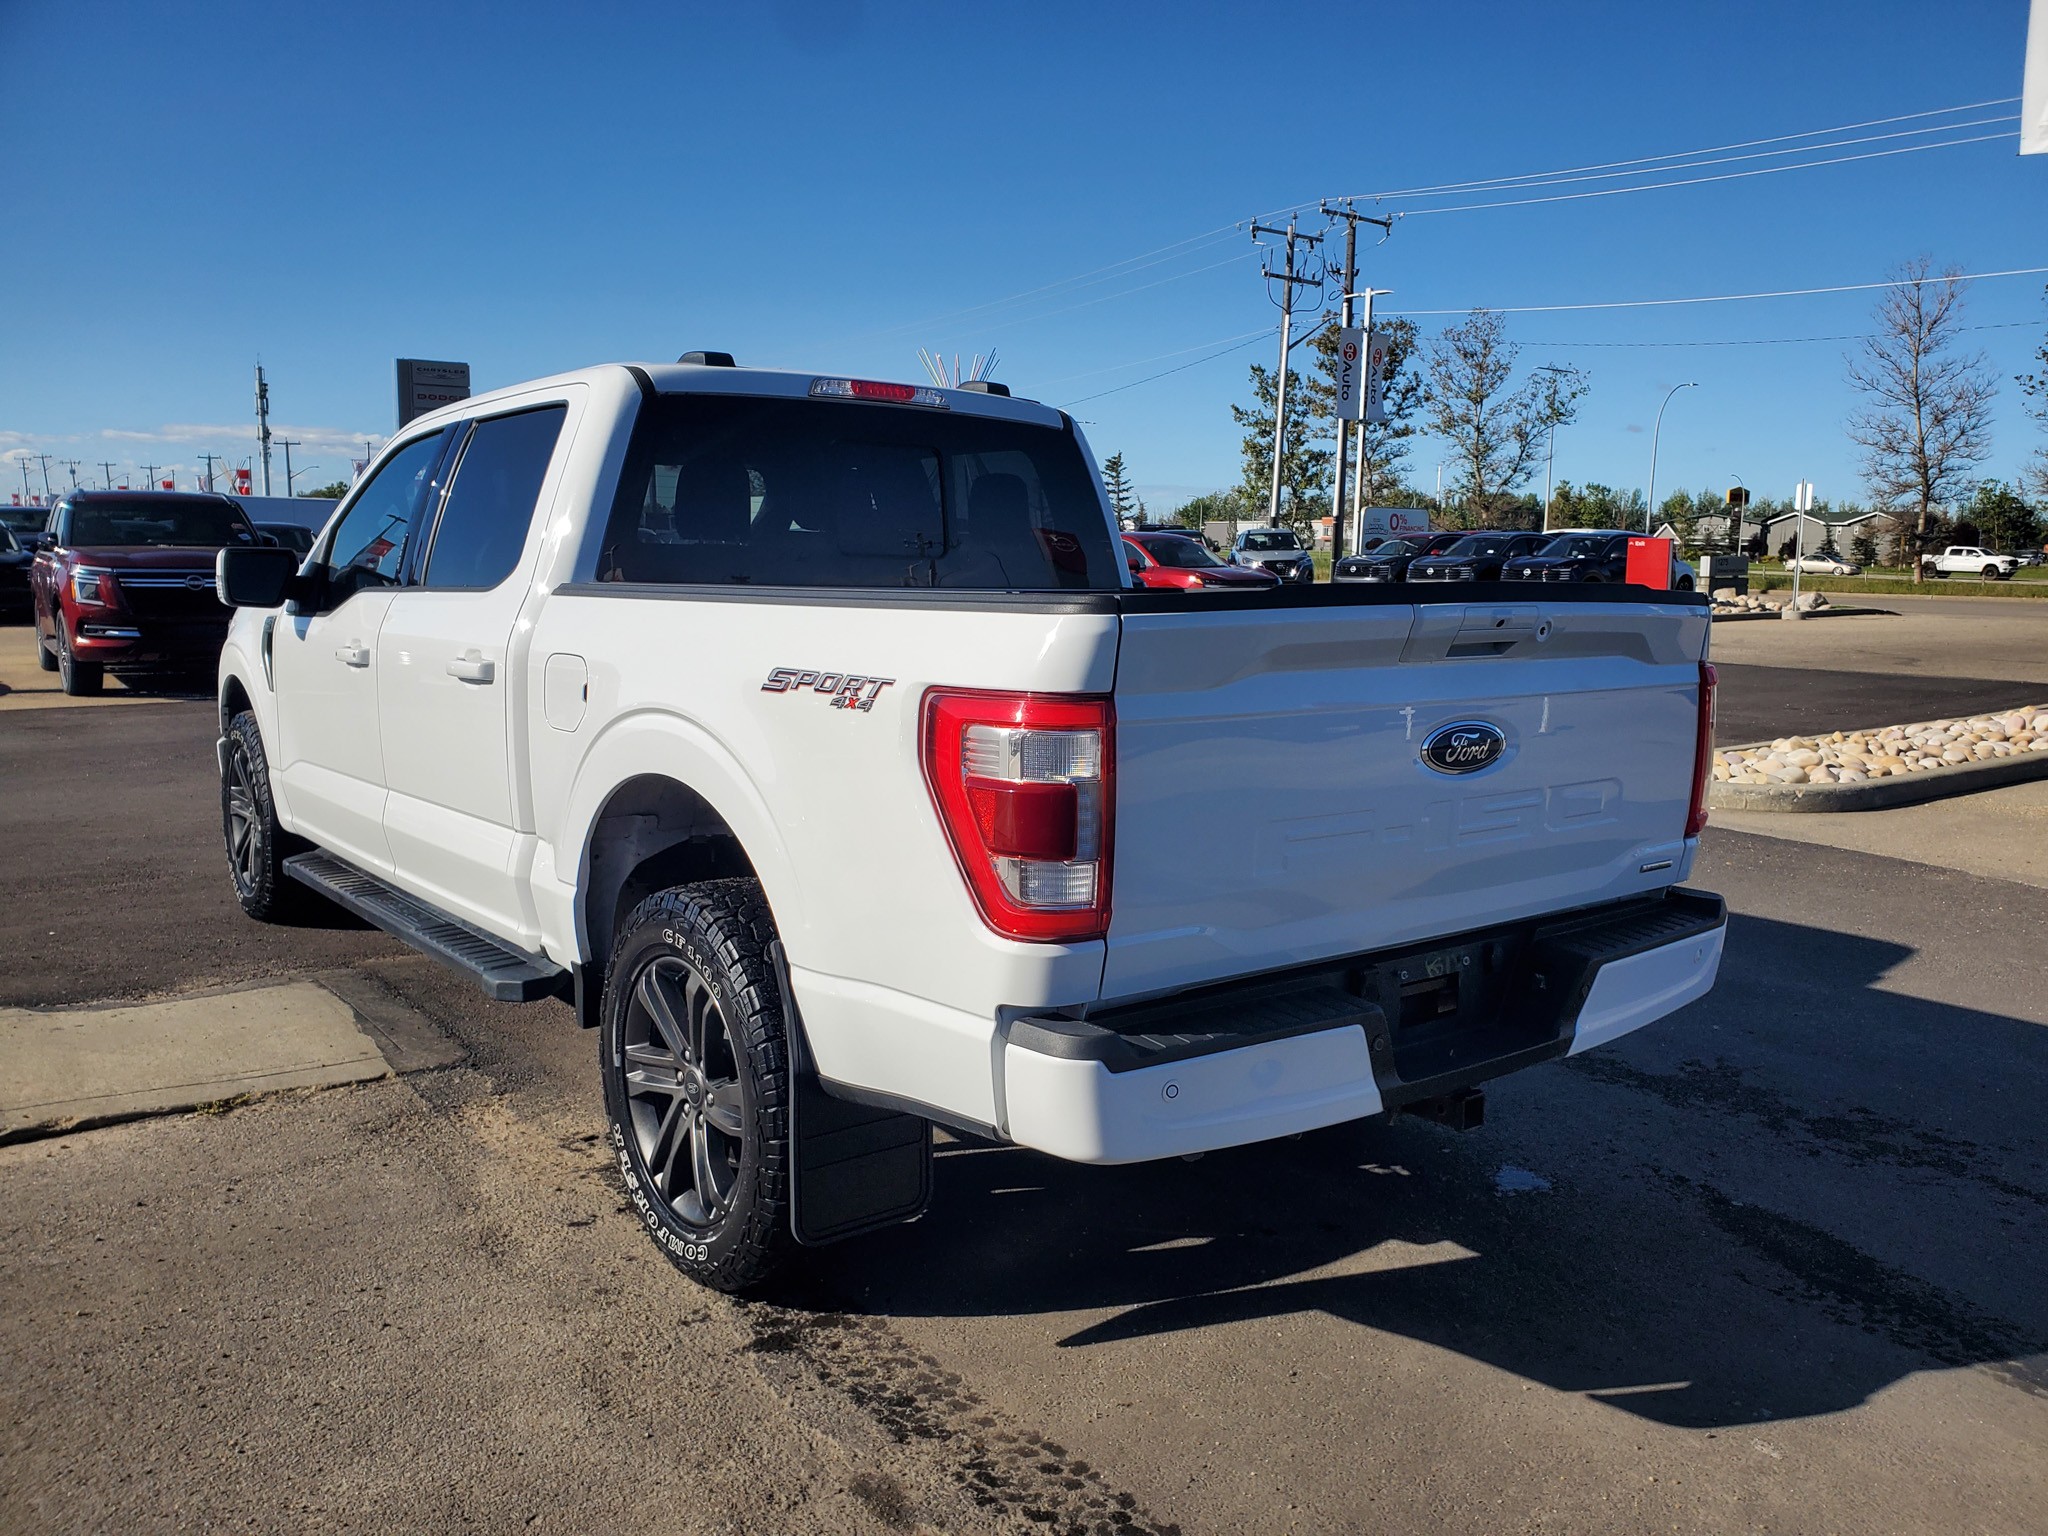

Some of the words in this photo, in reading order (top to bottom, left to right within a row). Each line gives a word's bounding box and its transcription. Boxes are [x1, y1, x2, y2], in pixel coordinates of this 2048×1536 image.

[1341, 361, 1352, 400] Auto
[761, 667, 897, 698] SPORT
[1445, 733, 1491, 763] Ford
